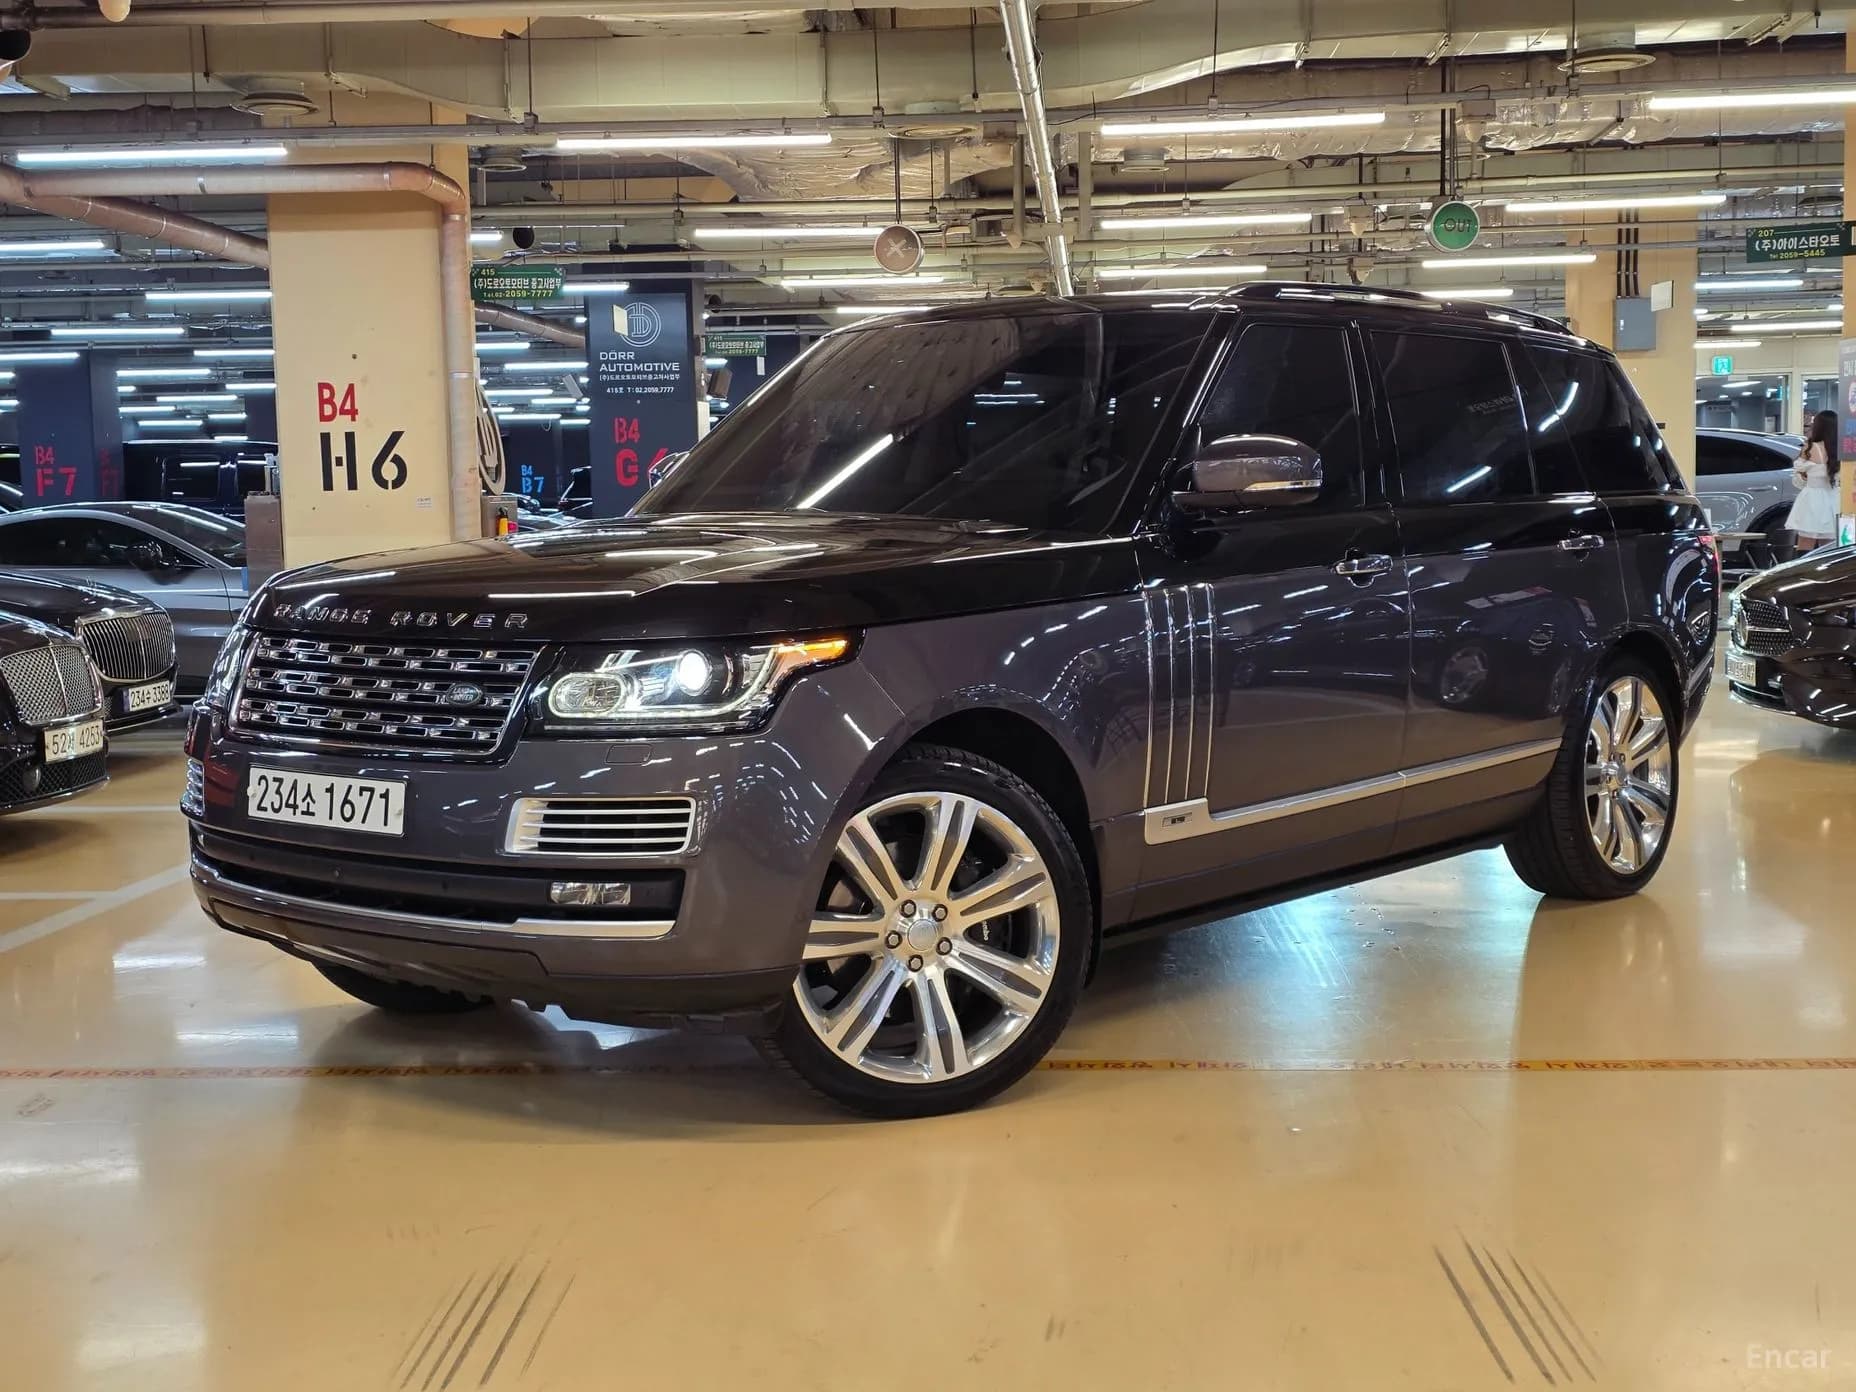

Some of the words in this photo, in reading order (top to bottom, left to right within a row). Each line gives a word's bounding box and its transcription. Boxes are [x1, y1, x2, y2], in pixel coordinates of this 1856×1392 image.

[1444, 218, 1472, 232] OUT
[1755, 234, 1840, 251] (주)아이스타오토
[600, 350, 635, 360] DÖRR
[600, 363, 680, 372] AUTOMOTIVE
[318, 382, 358, 422] B4
[615, 417, 640, 443] B4
[35, 446, 54, 464] B4
[521, 464, 532, 476] B4
[274, 603, 372, 625] RANGE
[389, 611, 529, 629] ROVER
[256, 775, 316, 816] 234소
[325, 782, 390, 826] 1671
